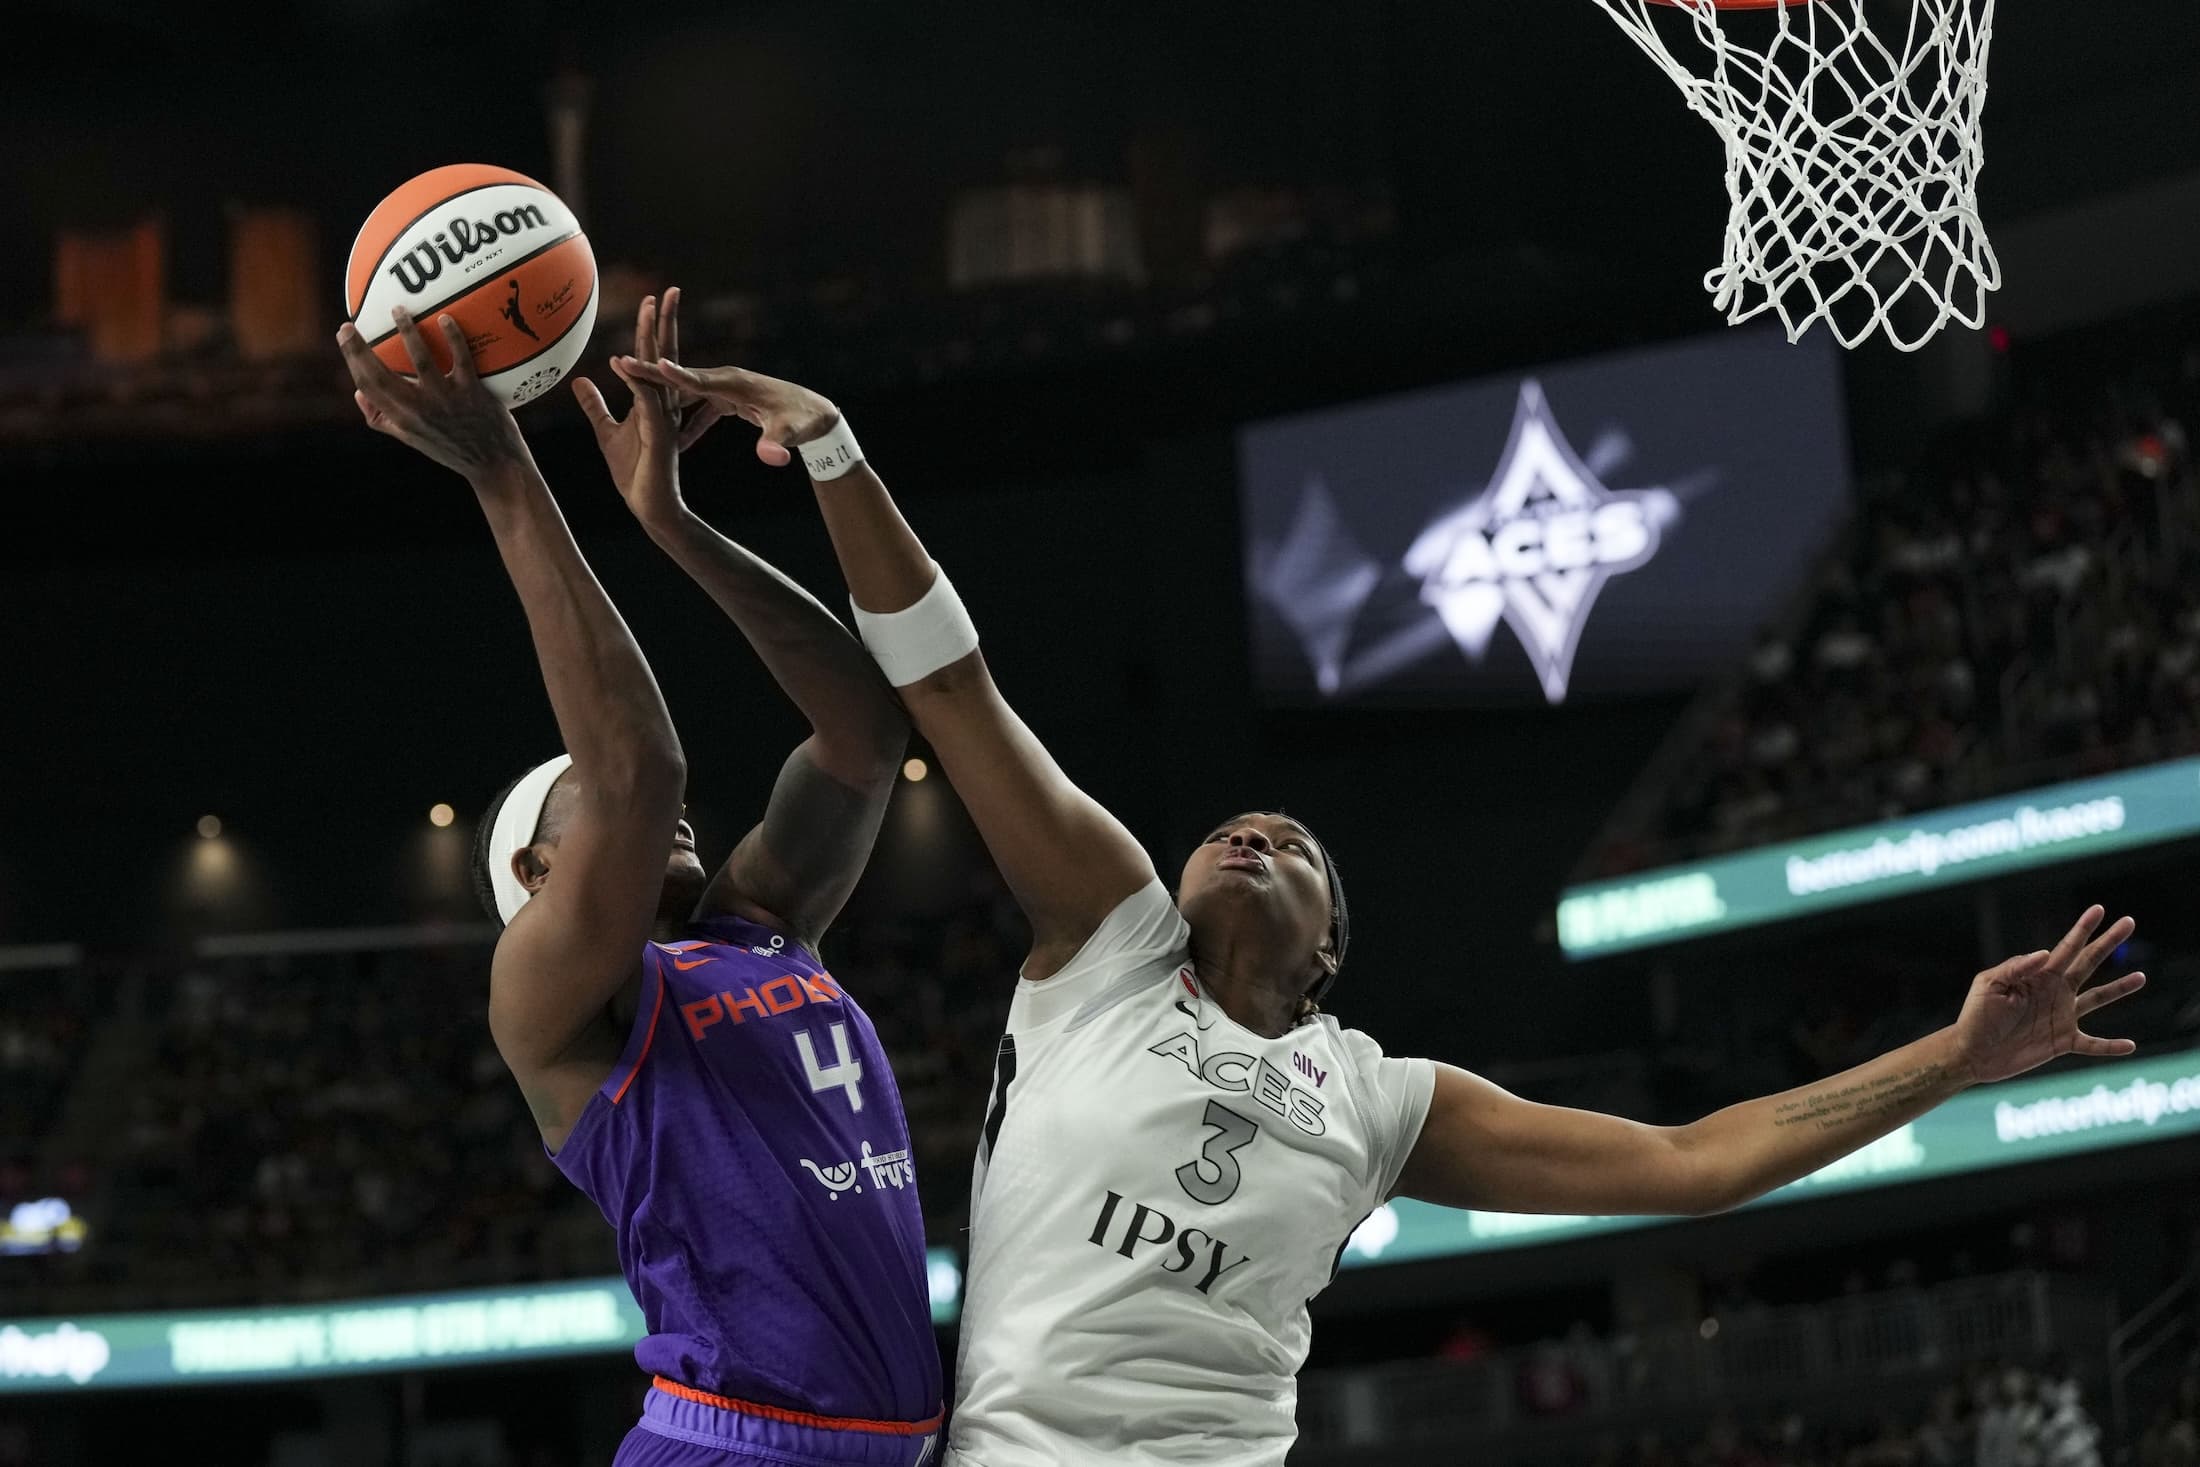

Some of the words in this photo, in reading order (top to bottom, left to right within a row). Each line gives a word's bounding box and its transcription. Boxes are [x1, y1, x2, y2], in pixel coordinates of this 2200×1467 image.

[389, 204, 549, 293] Wilson
[465, 260, 483, 273] EVO
[485, 249, 504, 261] NXT
[1441, 499, 1652, 588] ACES
[792, 1020, 864, 1114] 4
[1147, 1032, 1326, 1136] ACES
[1292, 1051, 1327, 1088] ally
[860, 1140, 914, 1191] fry's
[1175, 1099, 1259, 1206] 3
[1088, 1190, 1250, 1295] IPSY
